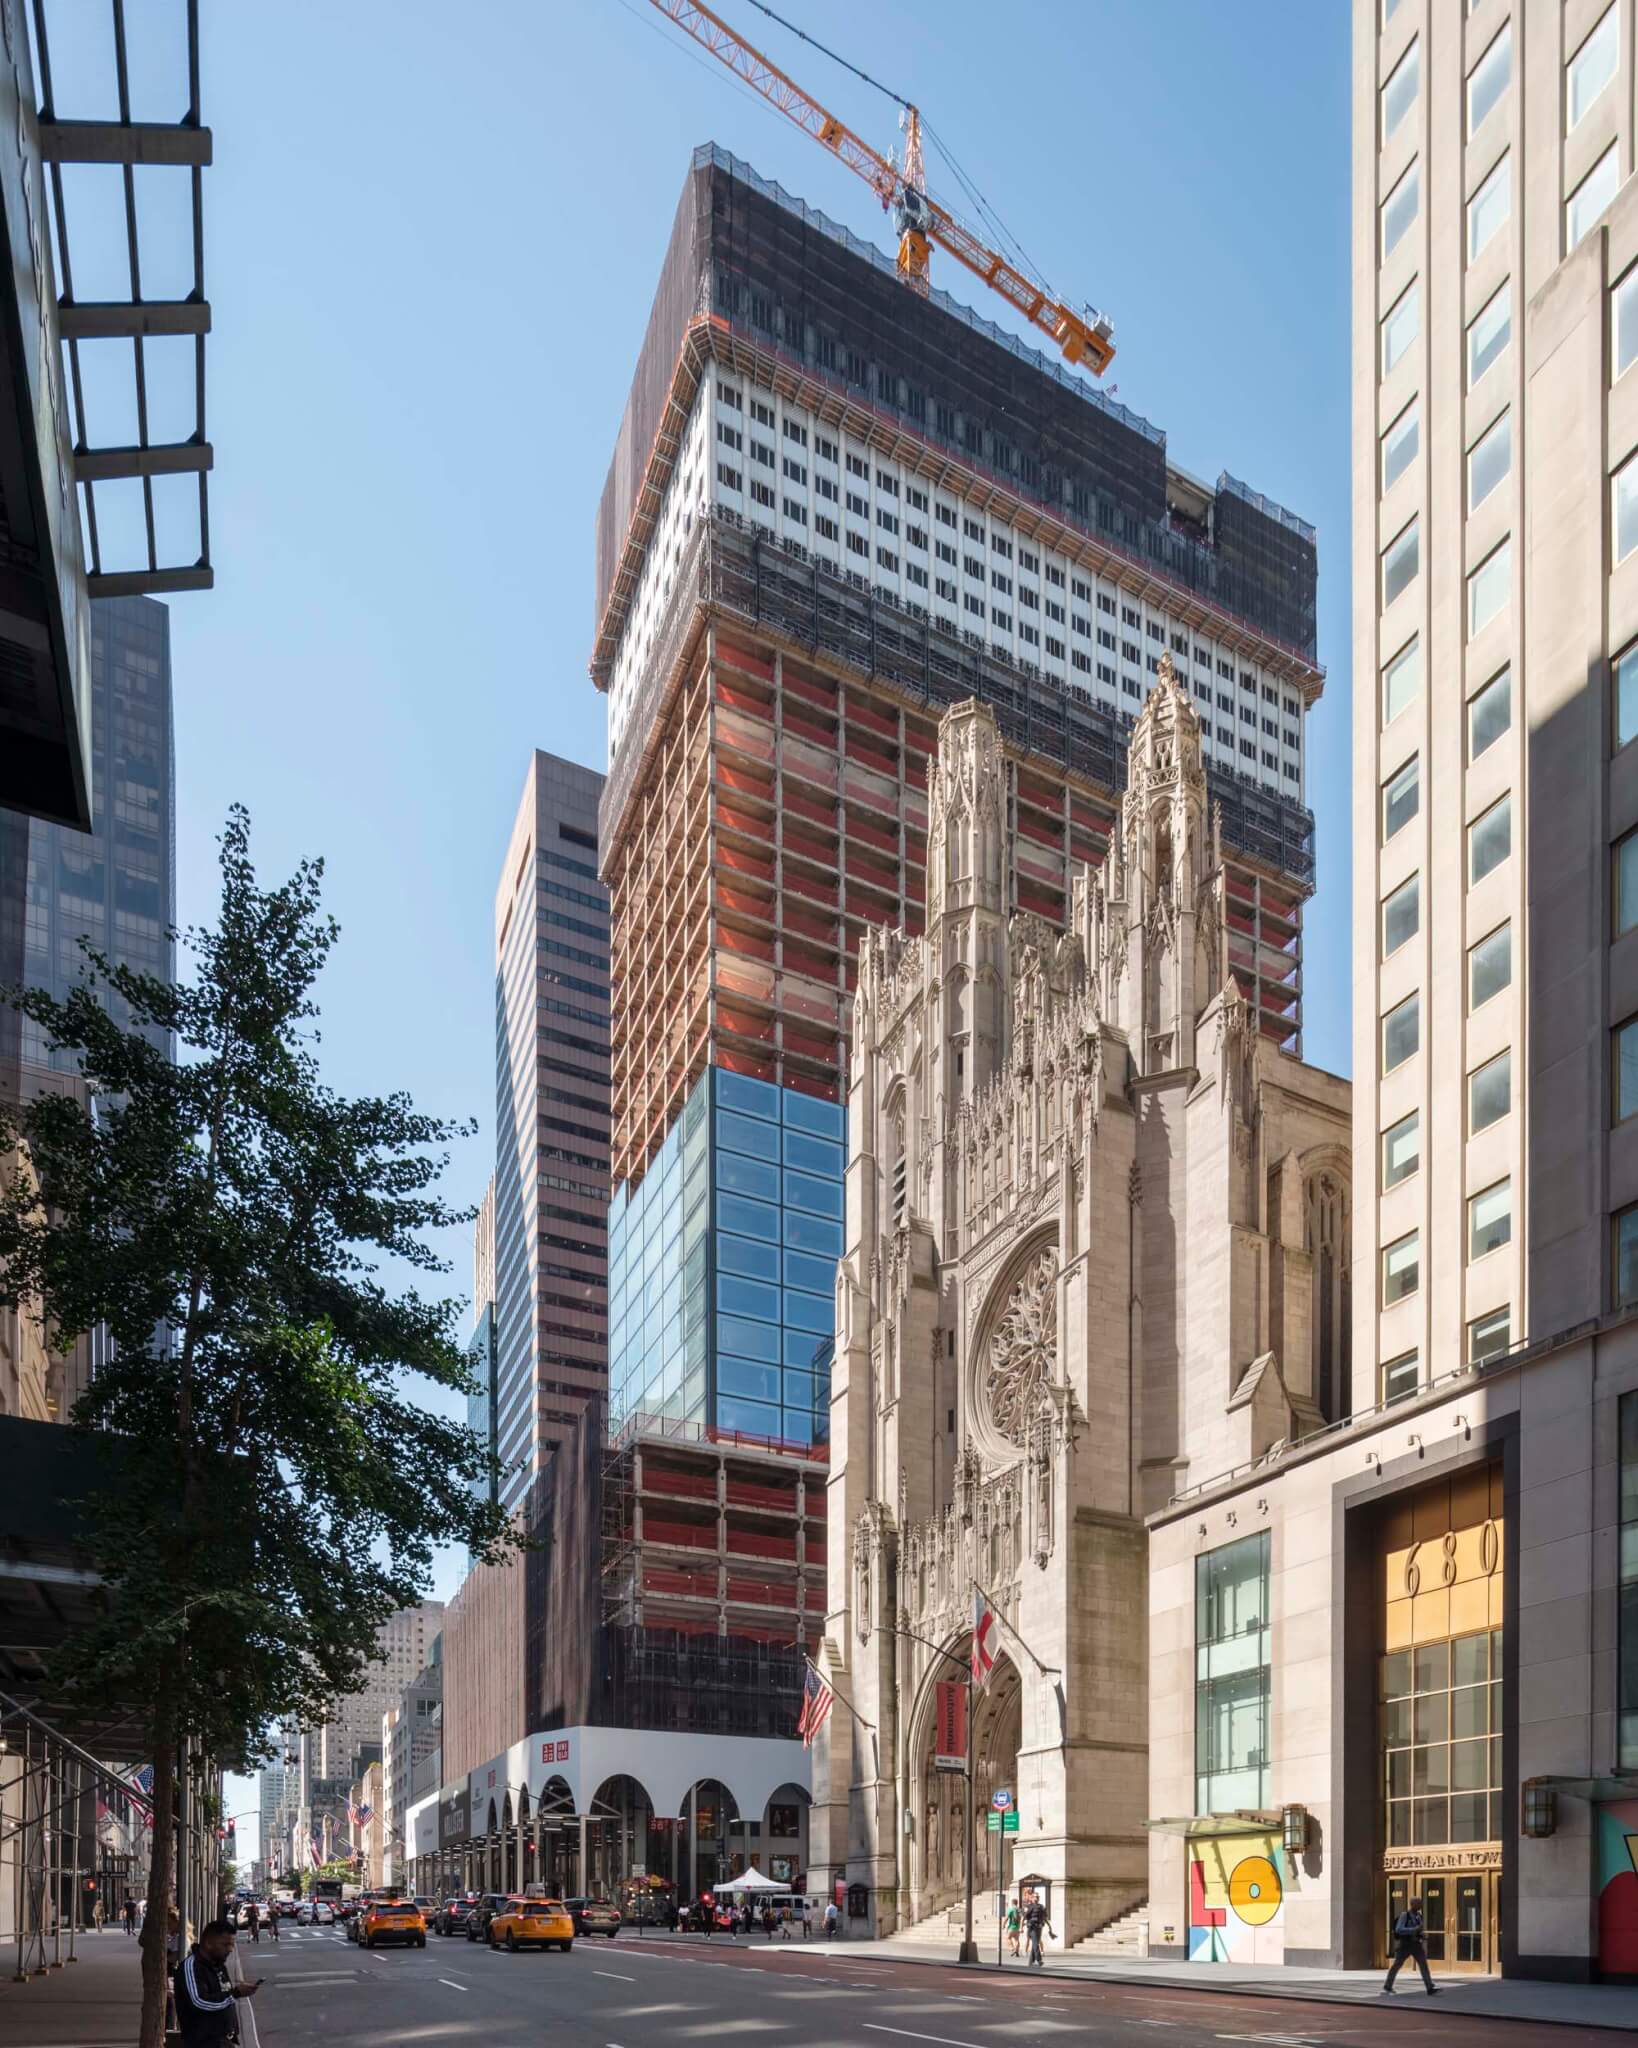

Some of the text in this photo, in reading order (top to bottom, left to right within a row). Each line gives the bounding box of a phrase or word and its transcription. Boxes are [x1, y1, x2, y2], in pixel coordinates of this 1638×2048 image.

[1405, 1519, 1498, 1598] 680
[945, 1686, 955, 1753] Automania
[1383, 1851, 1503, 1869] BUCHMANN TOW
